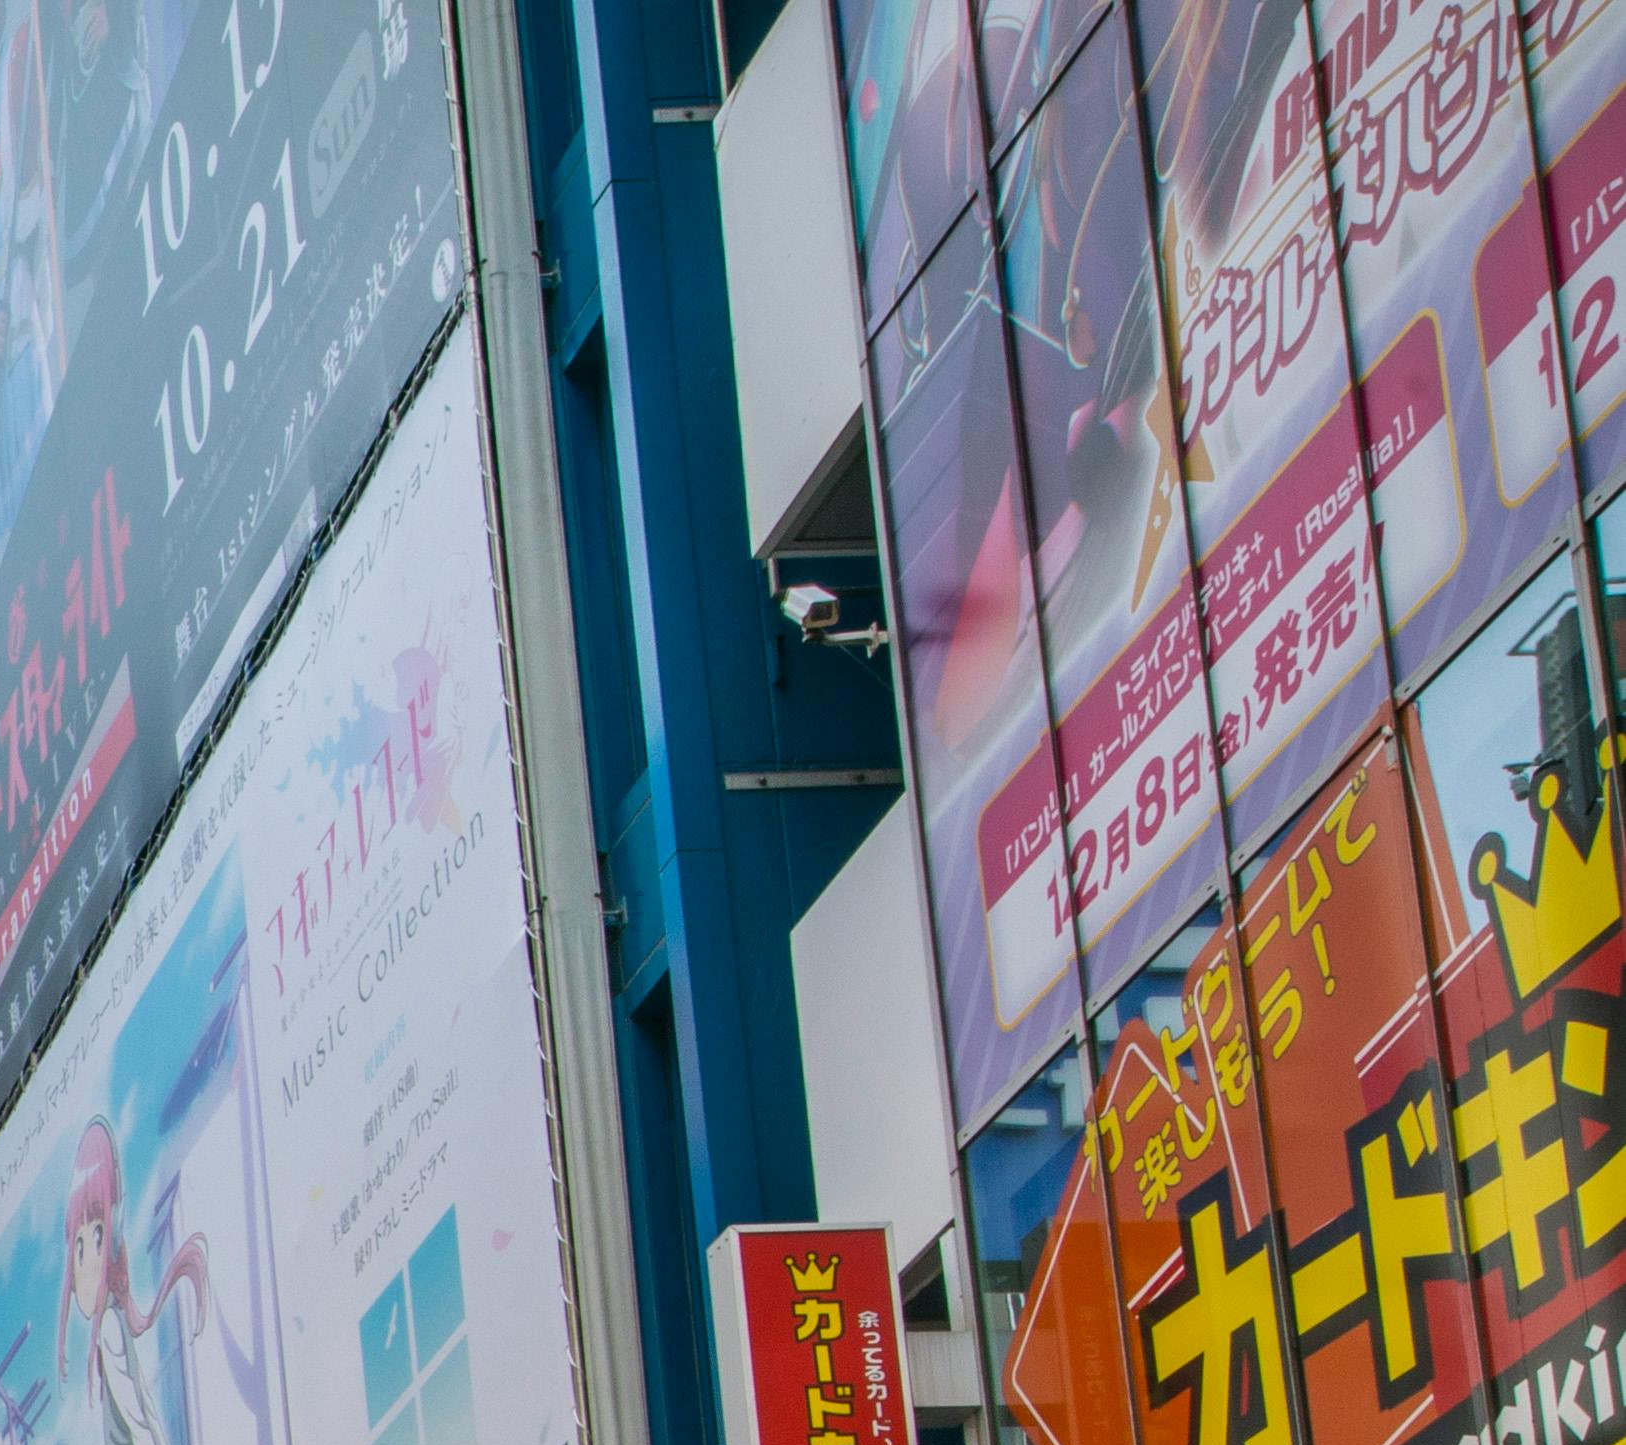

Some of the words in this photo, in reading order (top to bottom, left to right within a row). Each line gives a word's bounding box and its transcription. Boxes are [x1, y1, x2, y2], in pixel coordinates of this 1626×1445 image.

[153, 140, 308, 516] 10.21
[355, 788, 488, 1015] Collection
[1135, 921, 1336, 1222] 楽しもう!
